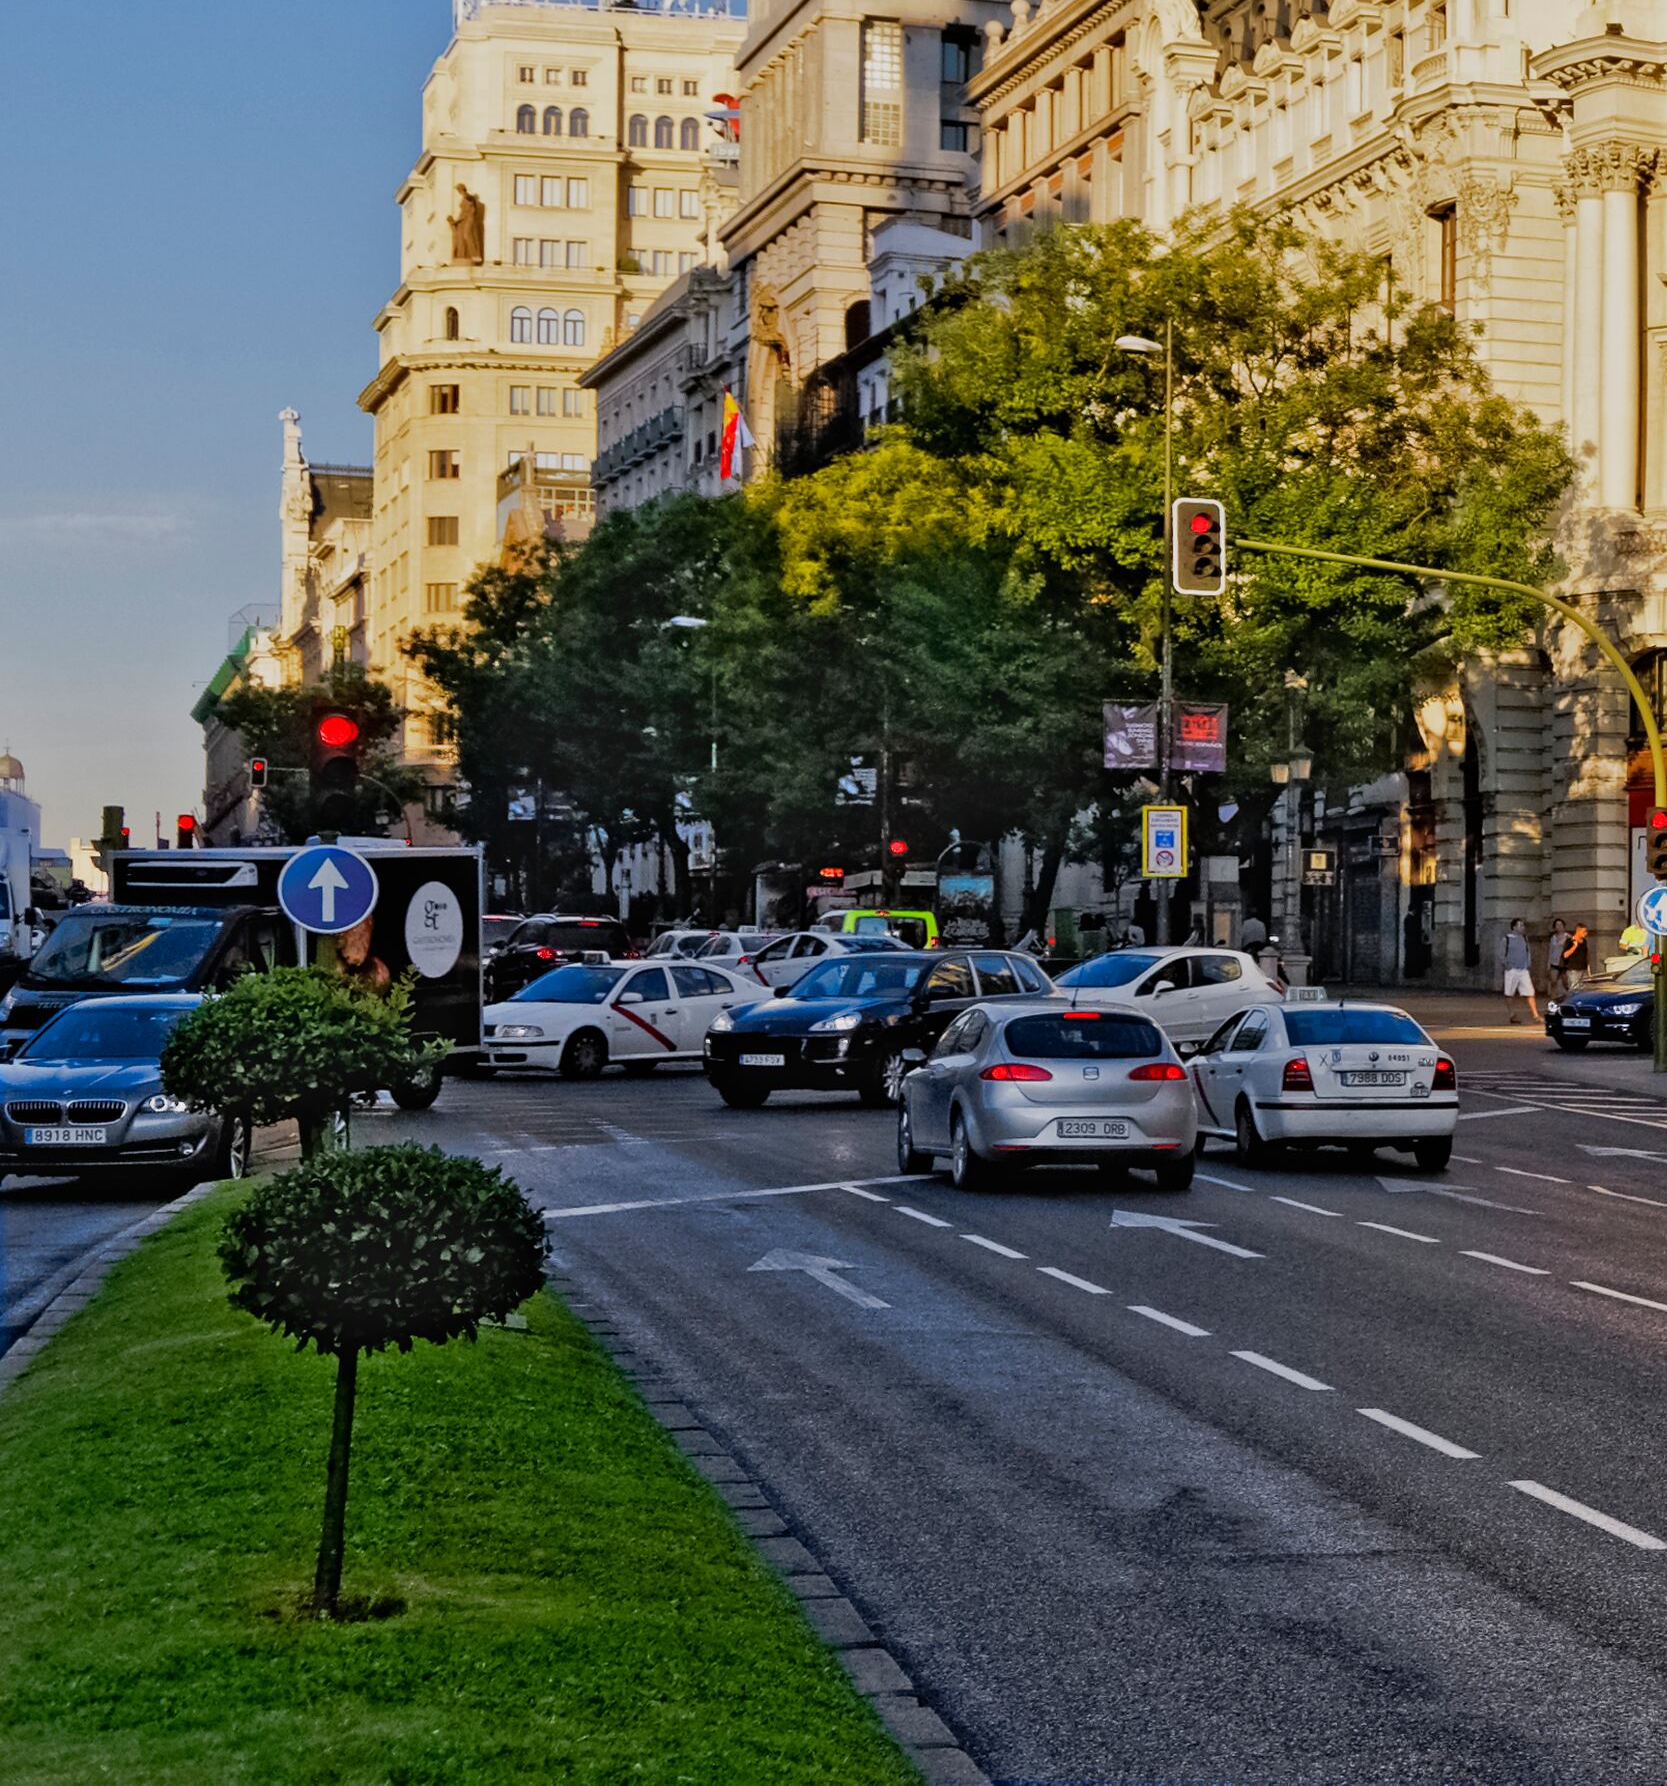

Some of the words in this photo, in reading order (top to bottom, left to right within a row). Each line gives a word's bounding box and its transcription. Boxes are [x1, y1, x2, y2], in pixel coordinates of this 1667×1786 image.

[1350, 1073, 1378, 1084] 7988
[1381, 1073, 1402, 1084] DDS
[1065, 1122, 1096, 1134] 2309
[1103, 1122, 1126, 1135] DRB
[34, 1129, 71, 1142] 8918
[75, 1129, 103, 1142] HNC
